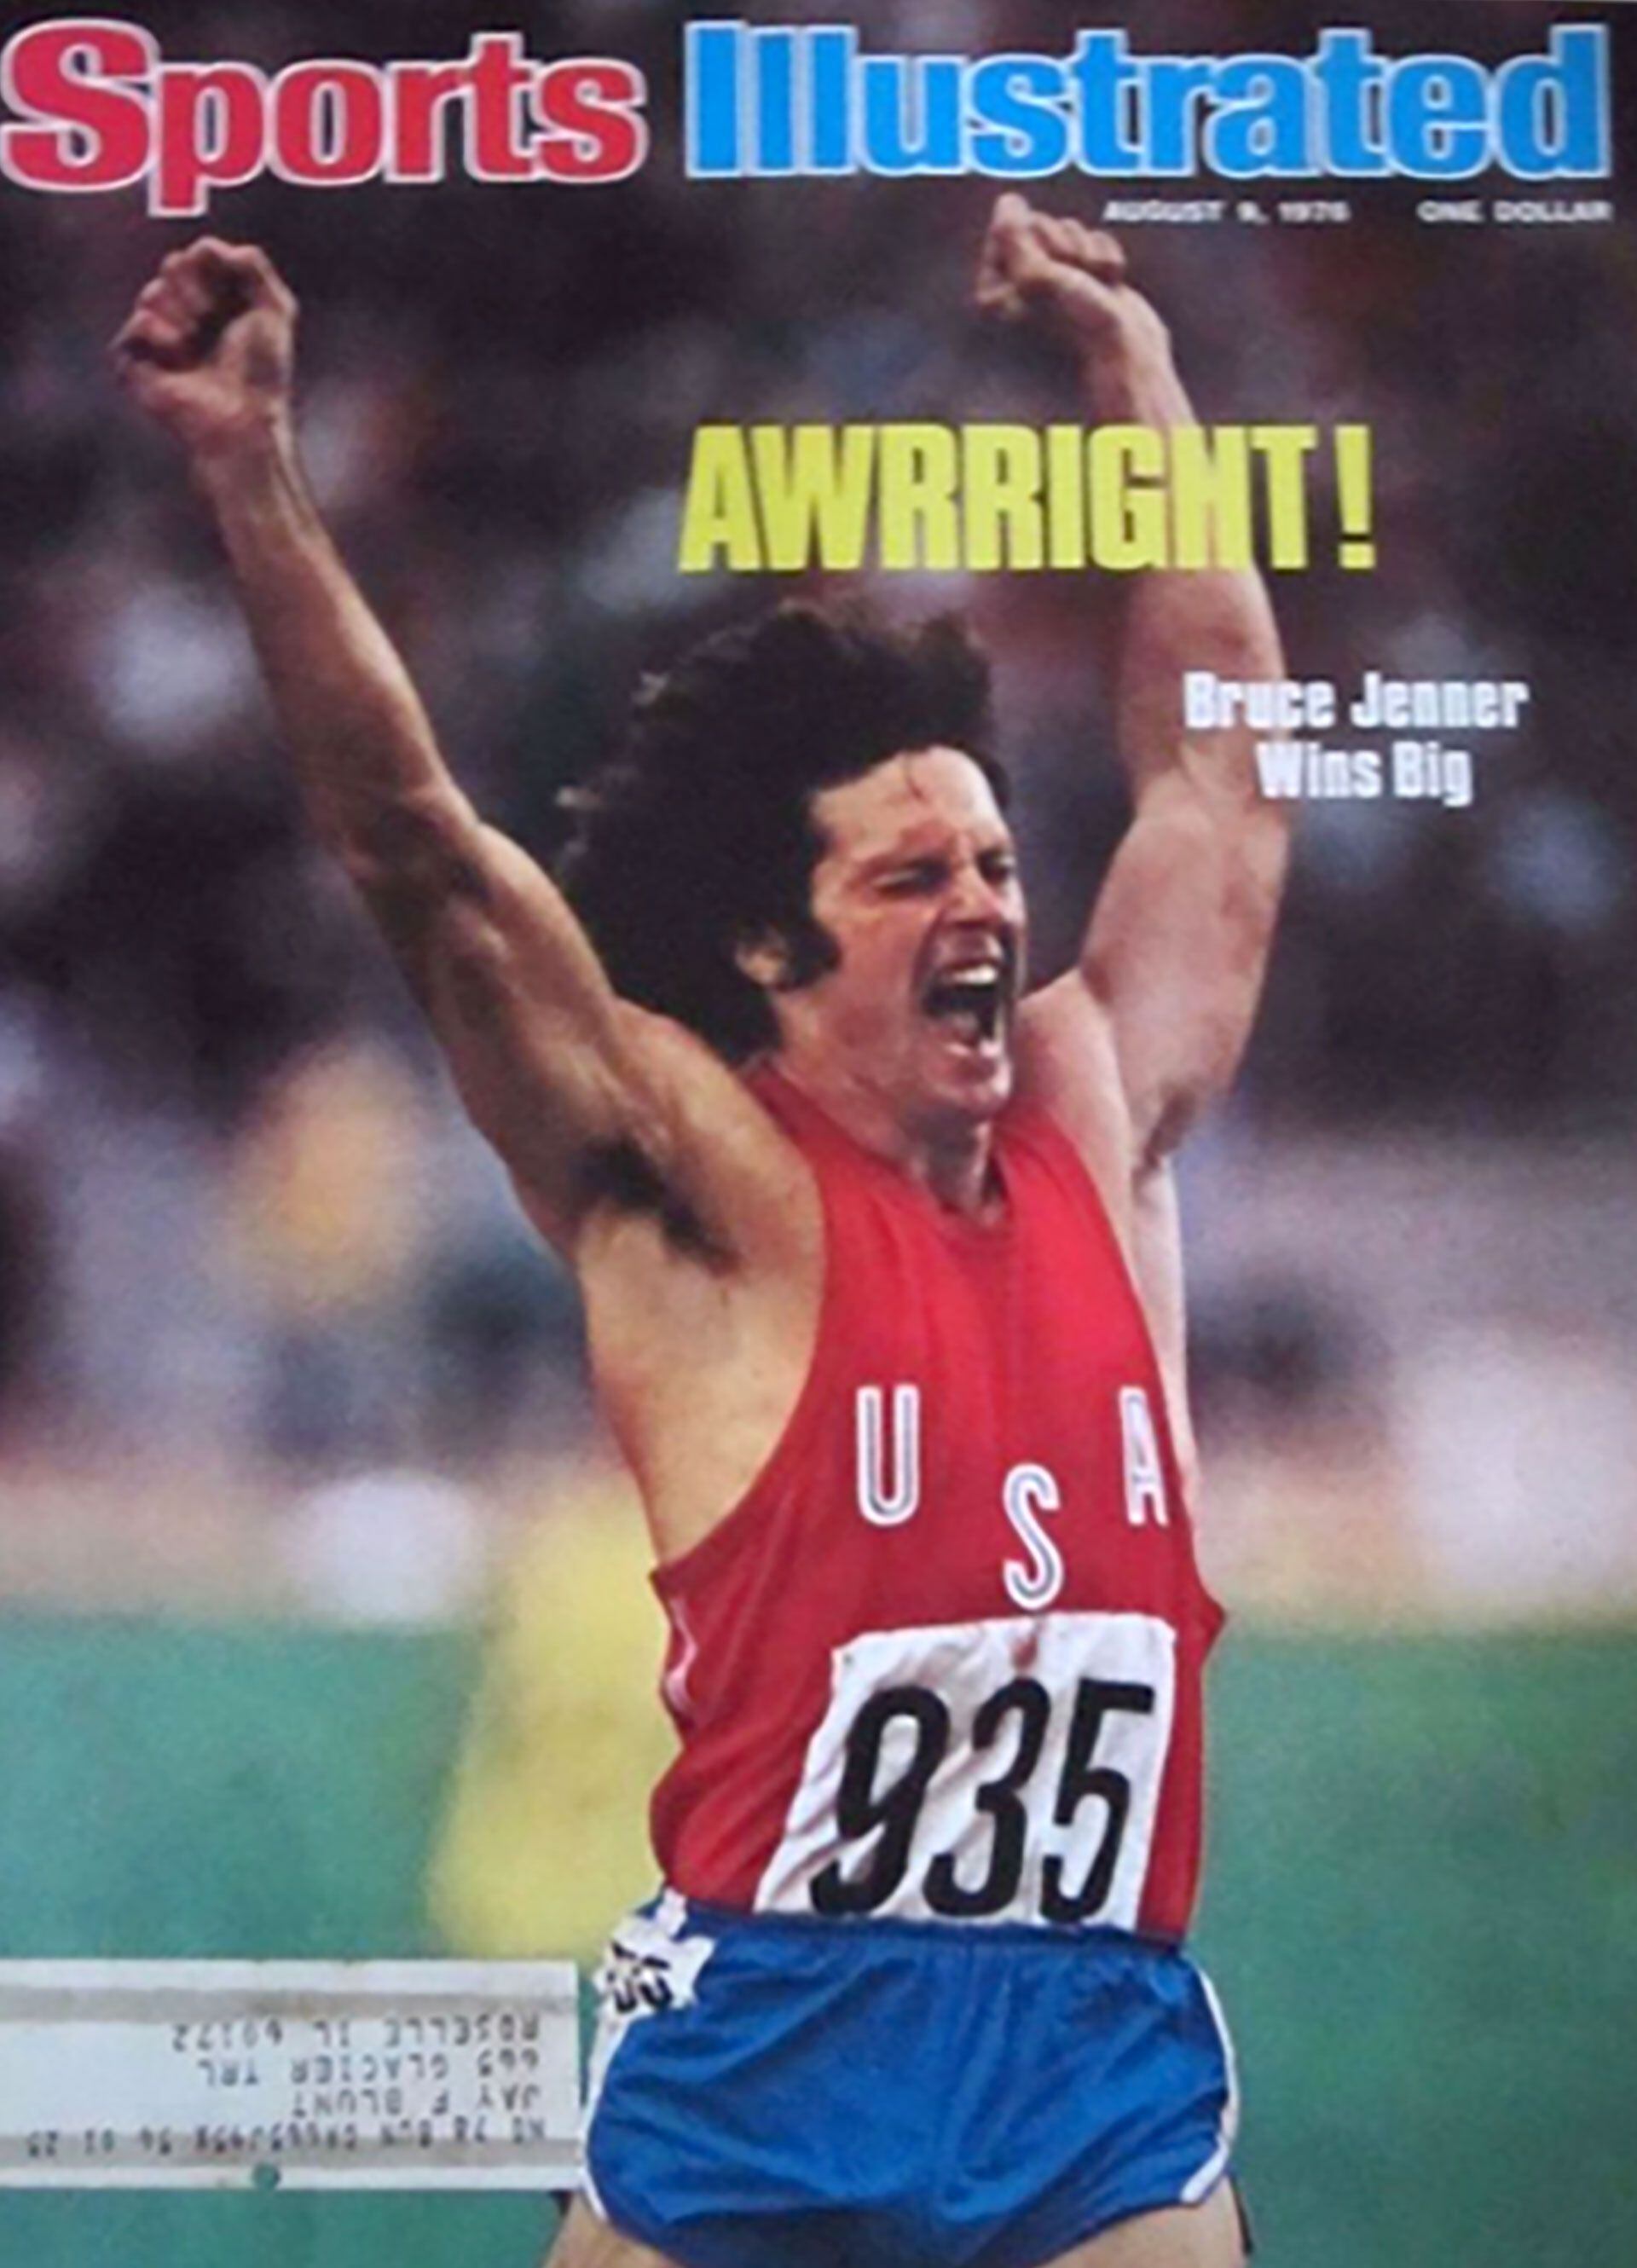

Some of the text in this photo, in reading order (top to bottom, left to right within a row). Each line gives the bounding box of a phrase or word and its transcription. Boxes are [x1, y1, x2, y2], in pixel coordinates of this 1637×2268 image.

[0, 19, 1610, 217] Sports Illustrated
[1103, 200, 1225, 222] AUGUST
[1417, 200, 1613, 223] ONE DOLLAR
[1183, 671, 1530, 728] Bruce Jenner
[1255, 741, 1473, 807] Wins Big
[808, 1675, 1155, 1925] 935
[172, 2013, 540, 2052] ROSELLE IL 60172
[198, 2058, 258, 2086] TRL
[292, 2052, 449, 2085] GLACIER
[292, 2084, 541, 2119] JAY F BLUNT
